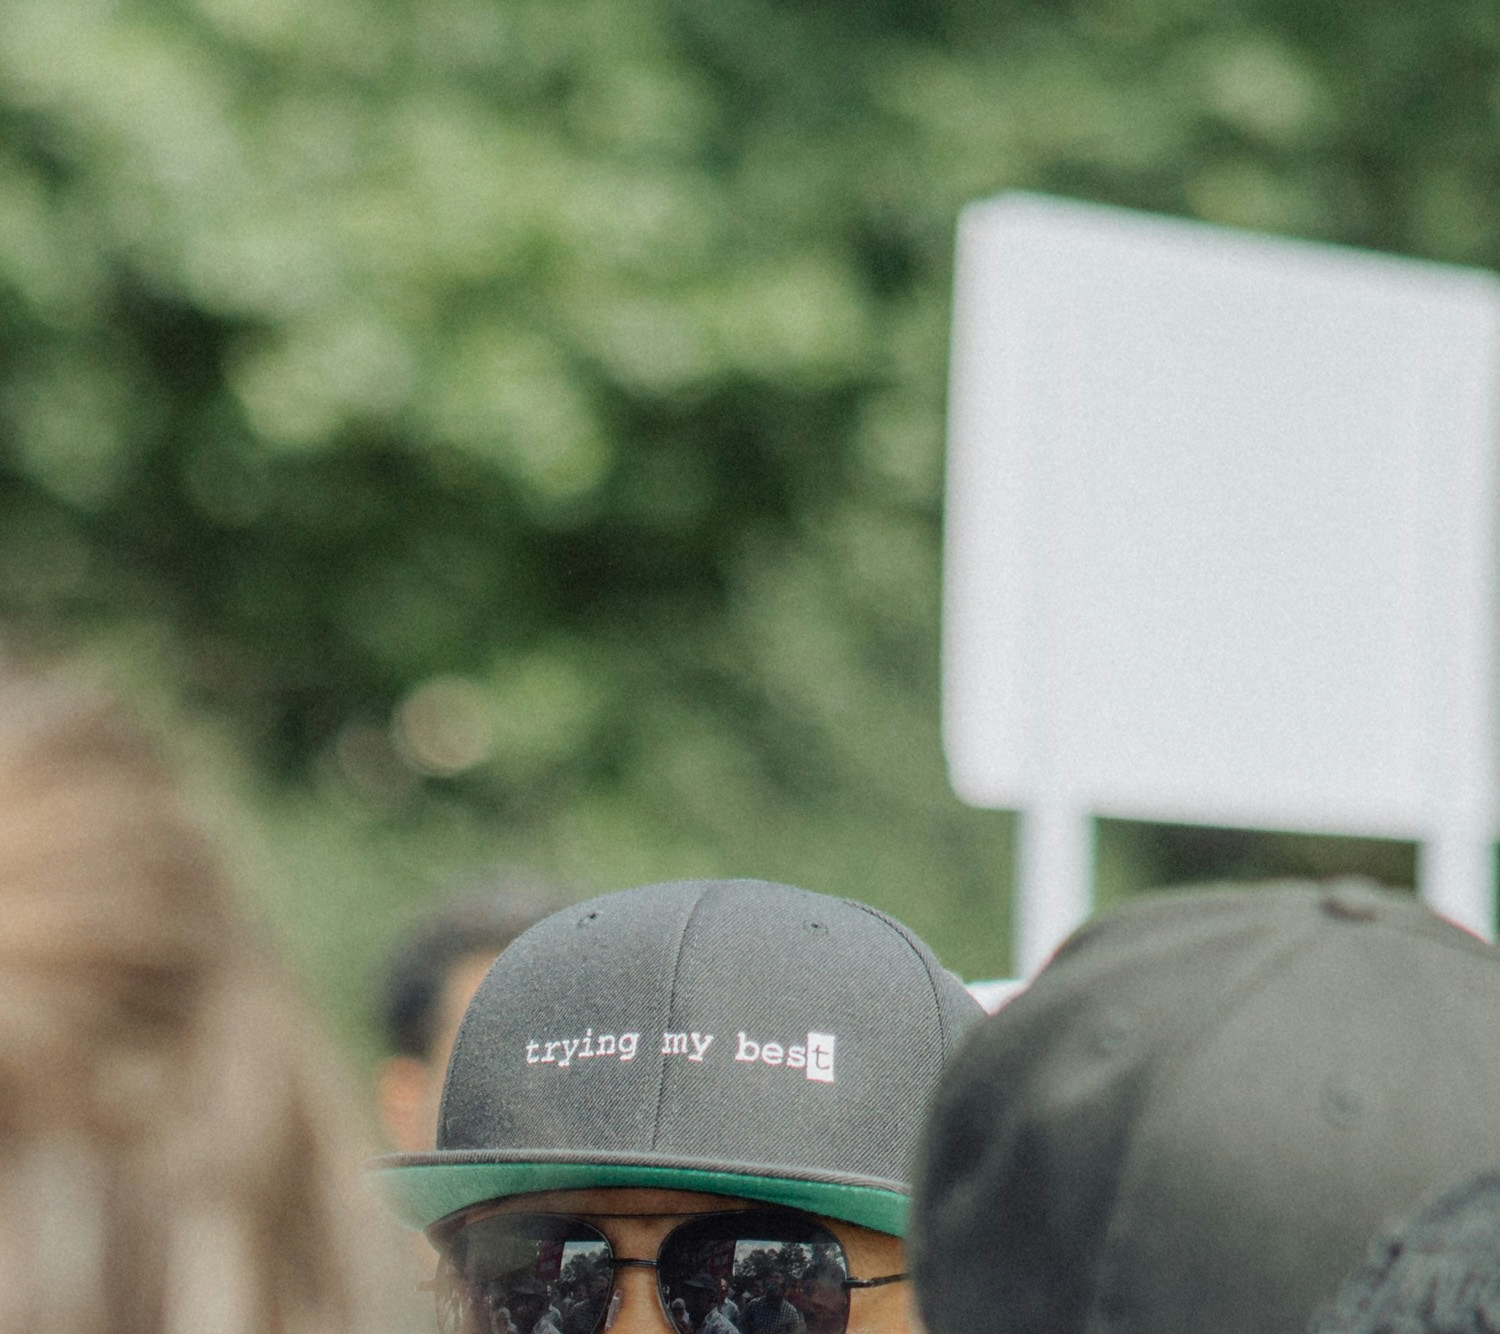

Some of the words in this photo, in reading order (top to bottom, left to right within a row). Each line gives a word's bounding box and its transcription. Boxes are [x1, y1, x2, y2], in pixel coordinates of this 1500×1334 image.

[525, 1028, 640, 1068] trying
[661, 1031, 715, 1063] my
[734, 1030, 833, 1073] best
